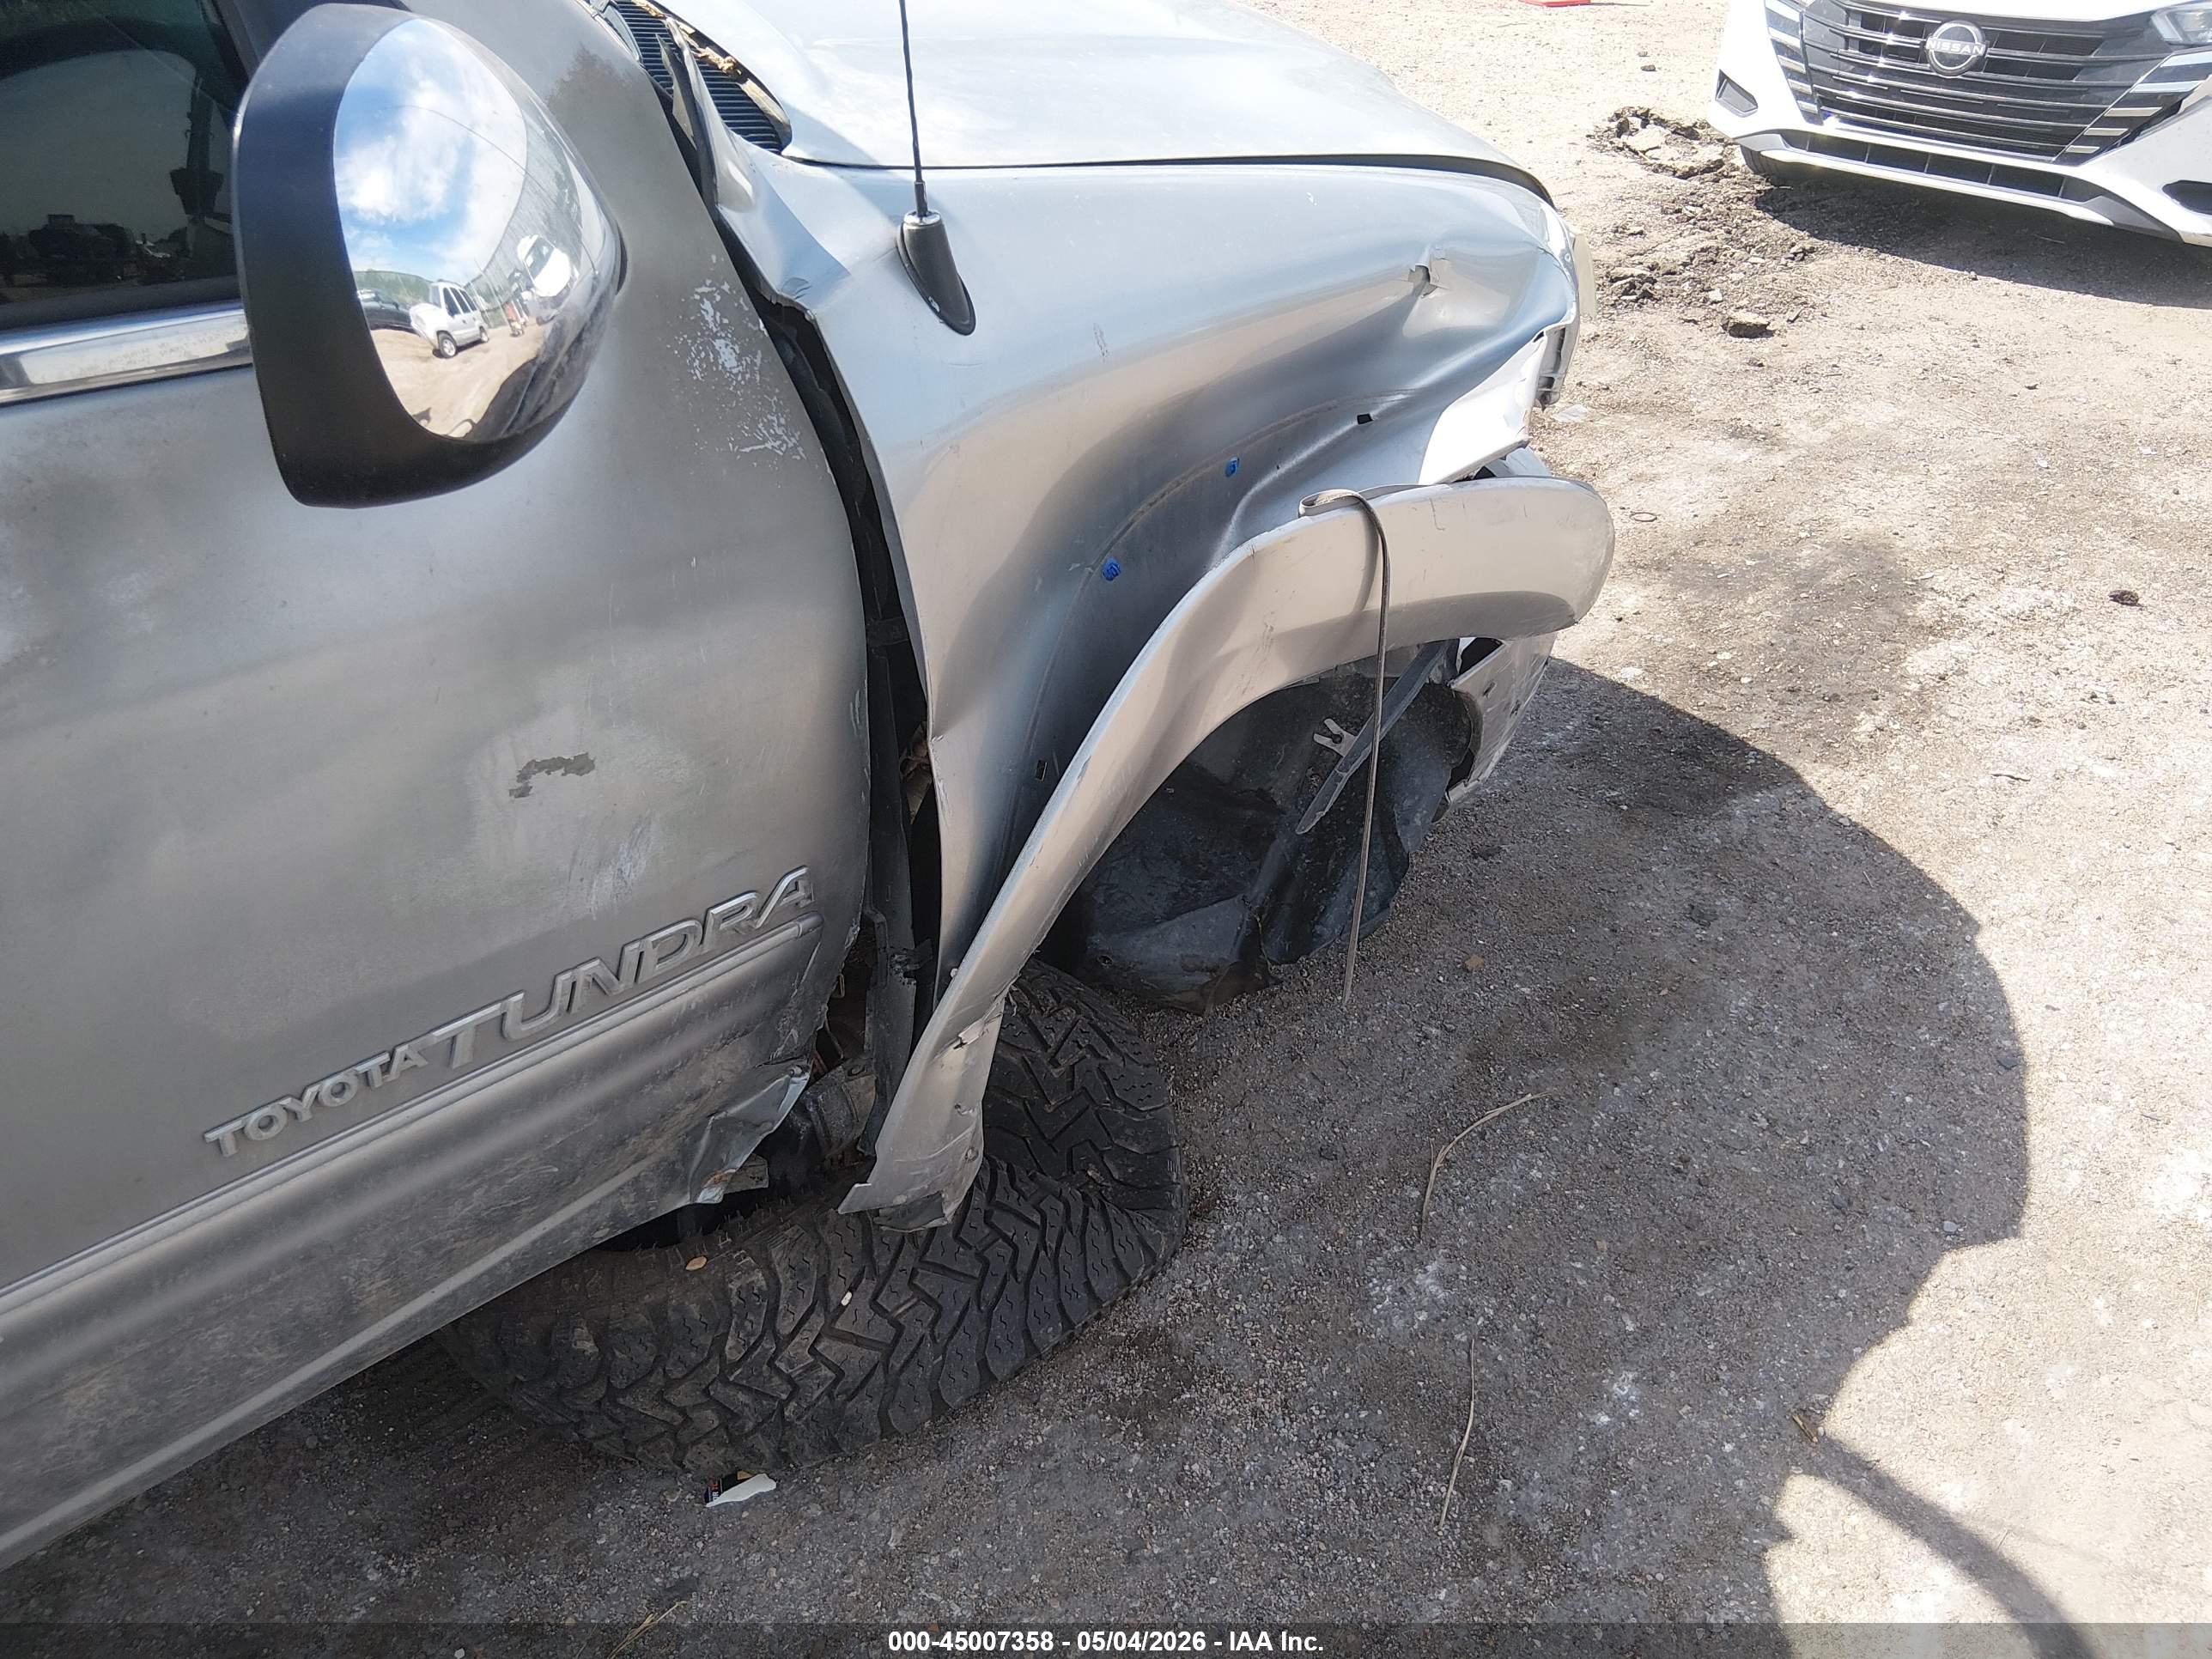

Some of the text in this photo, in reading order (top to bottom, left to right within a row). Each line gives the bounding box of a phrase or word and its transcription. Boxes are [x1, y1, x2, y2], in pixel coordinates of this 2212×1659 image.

[1926, 40, 1984, 55] NISSAN
[204, 866, 816, 1158] TOYOTA TUNDRA
